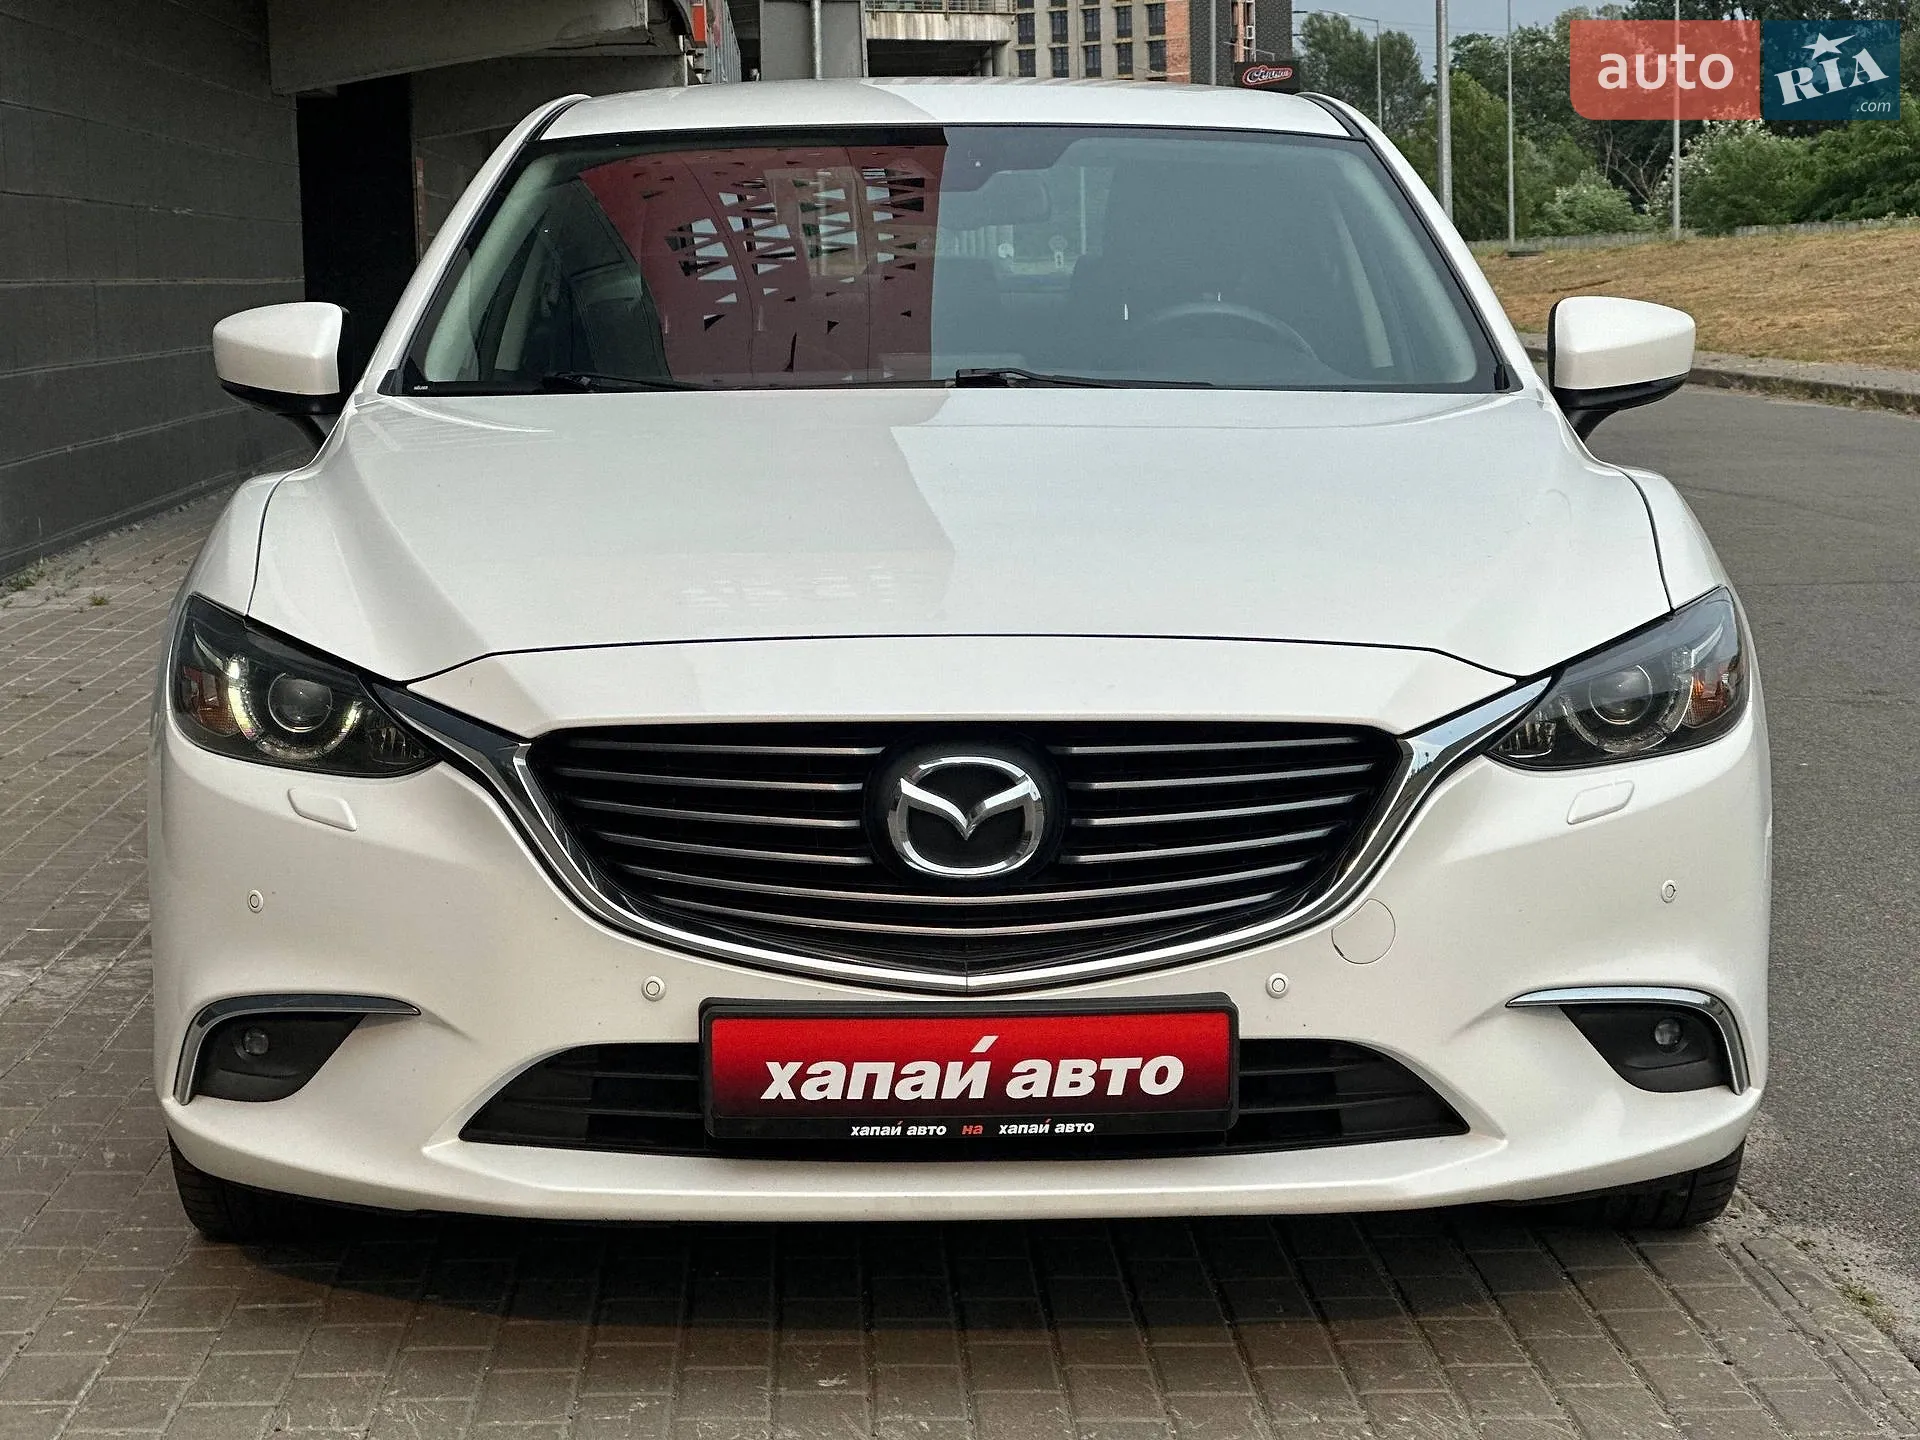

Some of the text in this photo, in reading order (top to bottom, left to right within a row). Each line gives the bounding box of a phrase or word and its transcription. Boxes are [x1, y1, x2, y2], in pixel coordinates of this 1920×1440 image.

[1005, 1055, 1184, 1098] авто
[906, 1125, 947, 1136] авто
[962, 1124, 984, 1135] на
[1054, 1122, 1095, 1134] авто
